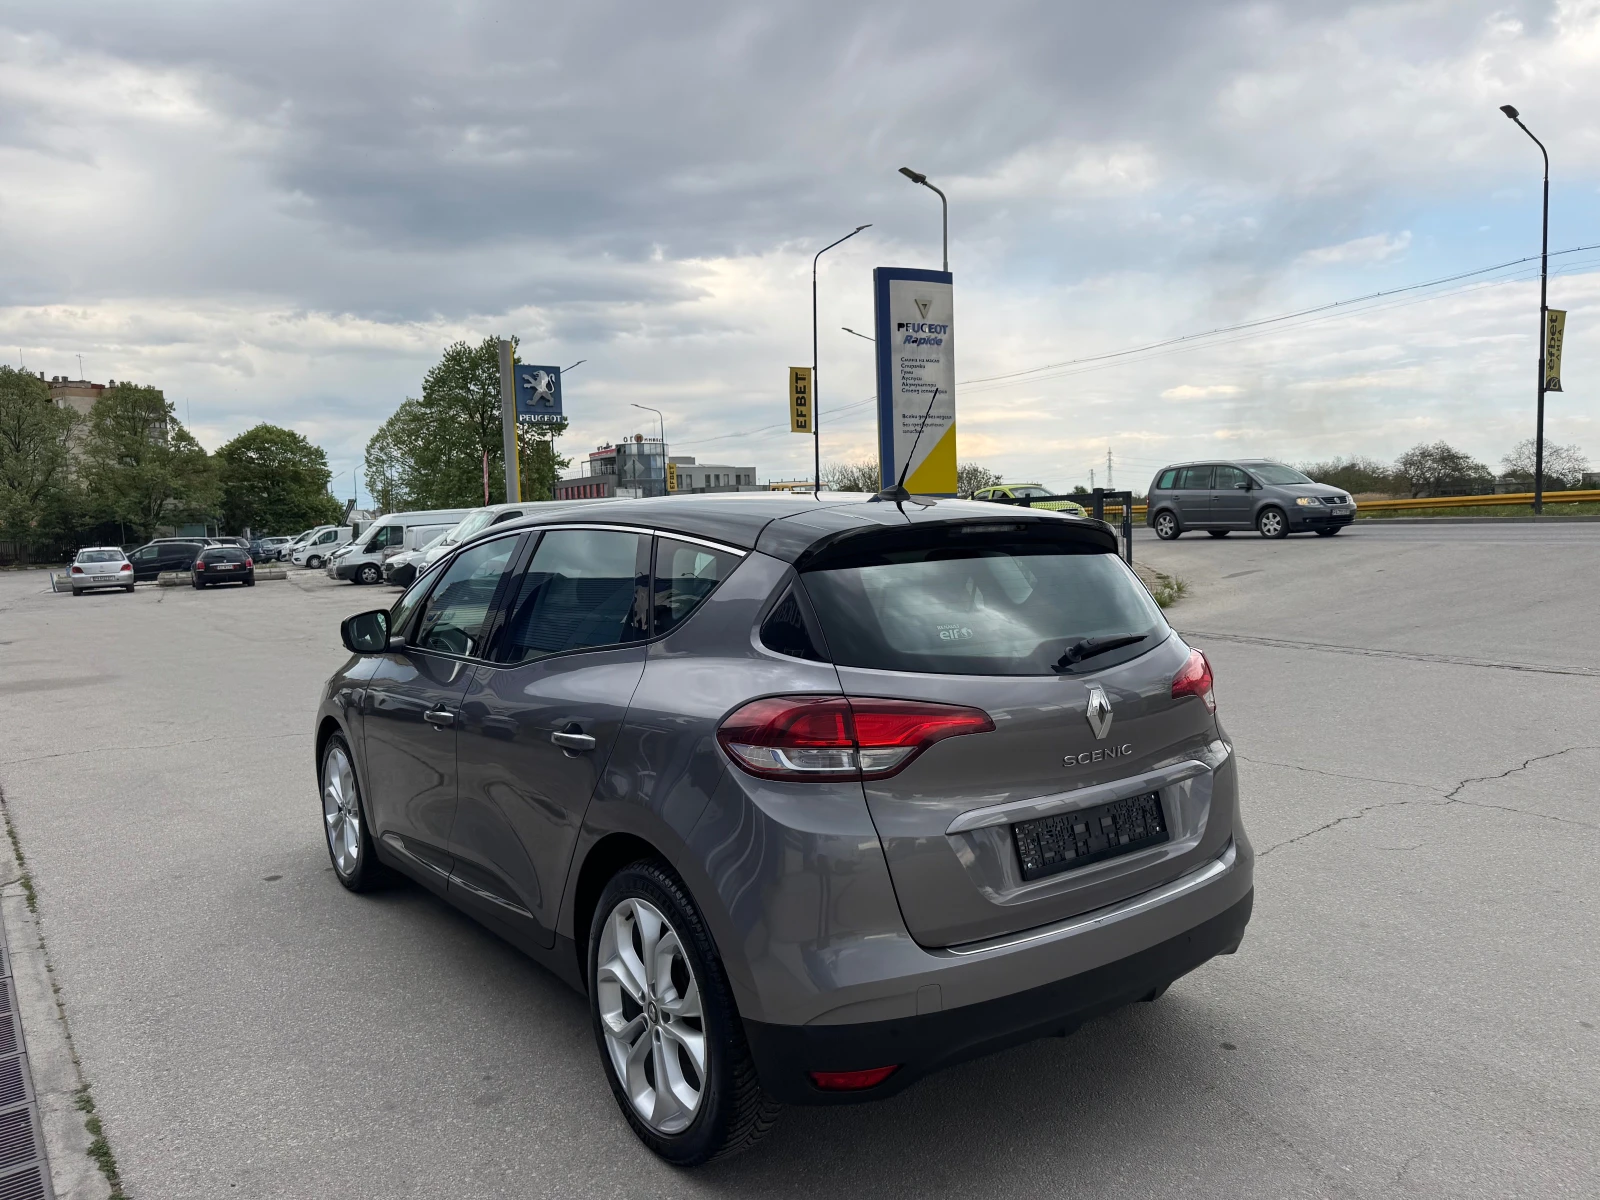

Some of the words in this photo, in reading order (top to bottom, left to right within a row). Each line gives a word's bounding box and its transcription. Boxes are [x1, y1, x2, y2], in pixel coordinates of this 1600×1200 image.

[897, 322, 949, 335] PEUGEOT
[903, 335, 943, 347] Rapide
[1548, 315, 1558, 371] efbet
[795, 371, 807, 429] EFBET
[519, 414, 562, 423] PEUGEOT
[939, 629, 960, 640] elf
[1063, 742, 1133, 767] SCENIC
